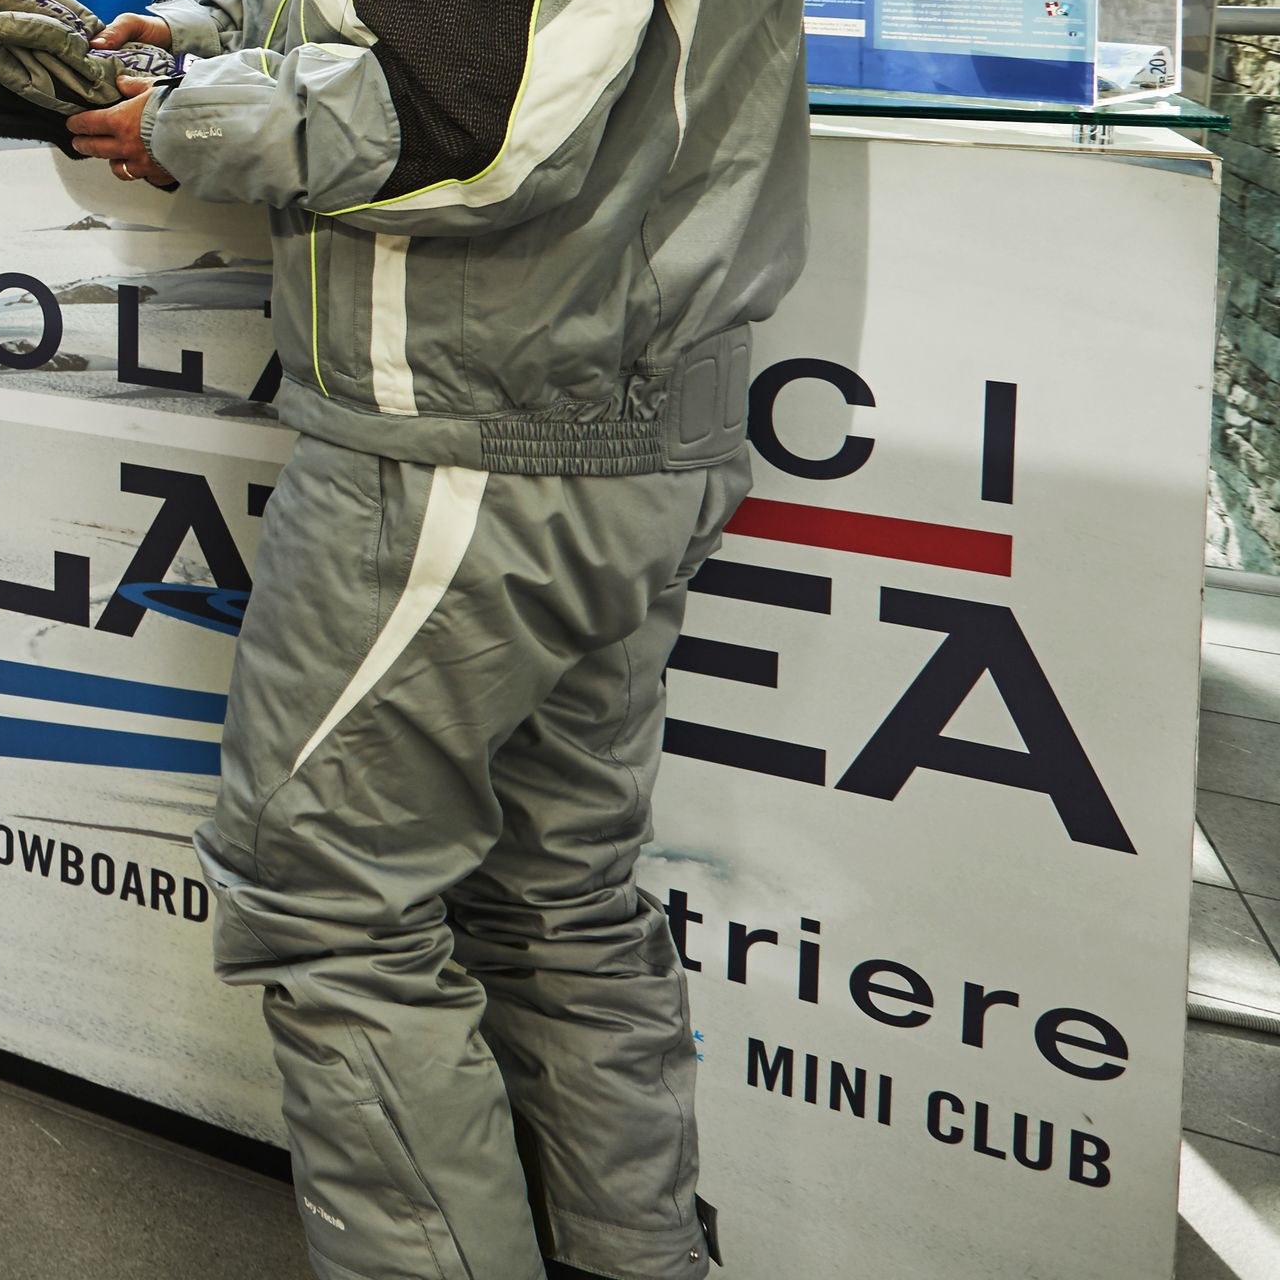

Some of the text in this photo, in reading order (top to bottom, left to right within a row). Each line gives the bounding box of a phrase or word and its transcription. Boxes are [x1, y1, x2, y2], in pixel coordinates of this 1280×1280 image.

[747, 357, 1018, 505] CI
[746, 1037, 1112, 1189] MINI CLUB
